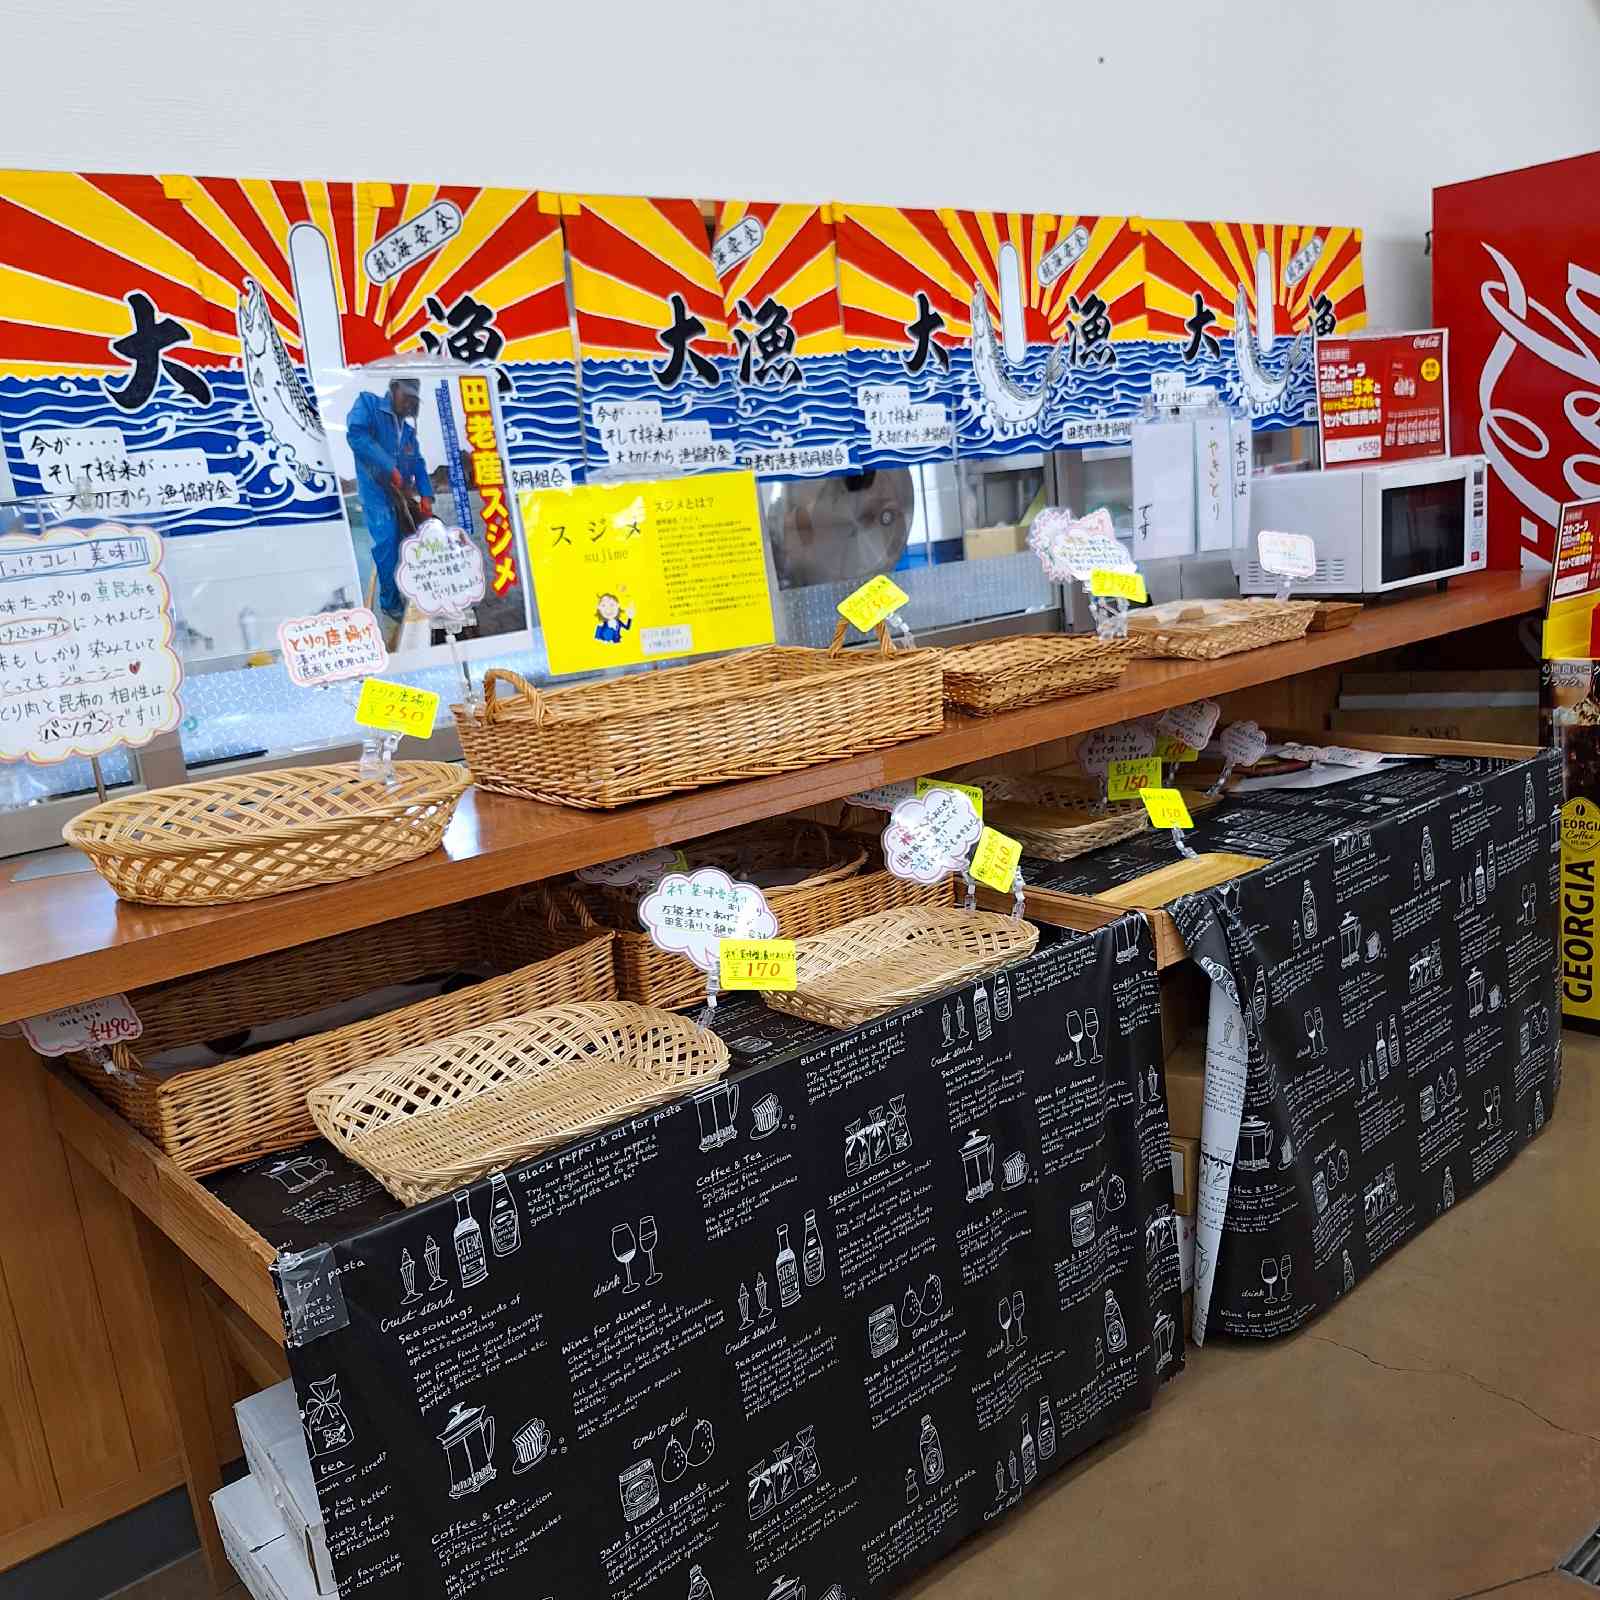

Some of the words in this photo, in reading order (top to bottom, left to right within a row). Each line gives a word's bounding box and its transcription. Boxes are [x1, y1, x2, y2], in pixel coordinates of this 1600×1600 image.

[654, 294, 802, 386] 大漁
[460, 376, 518, 594] 田老産スジメ
[1234, 435, 1249, 498] 本日は
[551, 518, 641, 547] スジメ
[1138, 503, 1153, 540] です
[1563, 860, 1595, 1003] GEORGIA
[801, 1051, 826, 1065] Black
[830, 1037, 858, 1057] pepper
[886, 1020, 898, 1030] for
[902, 1008, 925, 1026] pasta
[941, 1055, 984, 1078] Seasonings
[1070, 1075, 1096, 1088] dinner
[518, 1163, 553, 1182] Black
[559, 1142, 596, 1168] pepper
[612, 1129, 625, 1141] oil
[632, 1120, 649, 1133] for
[654, 1104, 683, 1126] pasta
[696, 1165, 730, 1186] Coffee
[744, 1152, 762, 1163] Tea
[828, 1182, 859, 1204] Special
[863, 1168, 890, 1185] aroma
[893, 1160, 906, 1170] tea
[297, 1278, 320, 1294] for
[327, 1259, 366, 1285] pasta
[399, 1306, 473, 1344] Seasonings
[424, 1333, 448, 1347] have
[451, 1320, 478, 1335] many
[481, 1304, 507, 1320] kinds
[511, 1294, 521, 1305] of
[562, 1335, 589, 1354] Wine
[593, 1323, 611, 1338] for
[616, 1300, 652, 1324] dinner
[435, 1358, 452, 1370] can
[457, 1345, 479, 1359] find
[483, 1333, 503, 1352] your
[508, 1313, 543, 1336] favorite
[435, 1364, 458, 1381] from
[463, 1354, 480, 1366] our
[529, 1323, 540, 1333] of
[735, 1336, 787, 1369] Seasonings
[449, 1366, 476, 1383] spices
[481, 1353, 500, 1367] and
[456, 1373, 482, 1389] sauce
[485, 1362, 501, 1377] for
[321, 1460, 345, 1474] tea
[345, 1473, 357, 1483] or
[432, 1519, 477, 1545] Coffee
[495, 1498, 517, 1515] Tea
[634, 1508, 664, 1532] bread
[668, 1483, 708, 1512] spreads
[335, 1529, 390, 1559] refreshing
[358, 1553, 400, 1579] favorite
